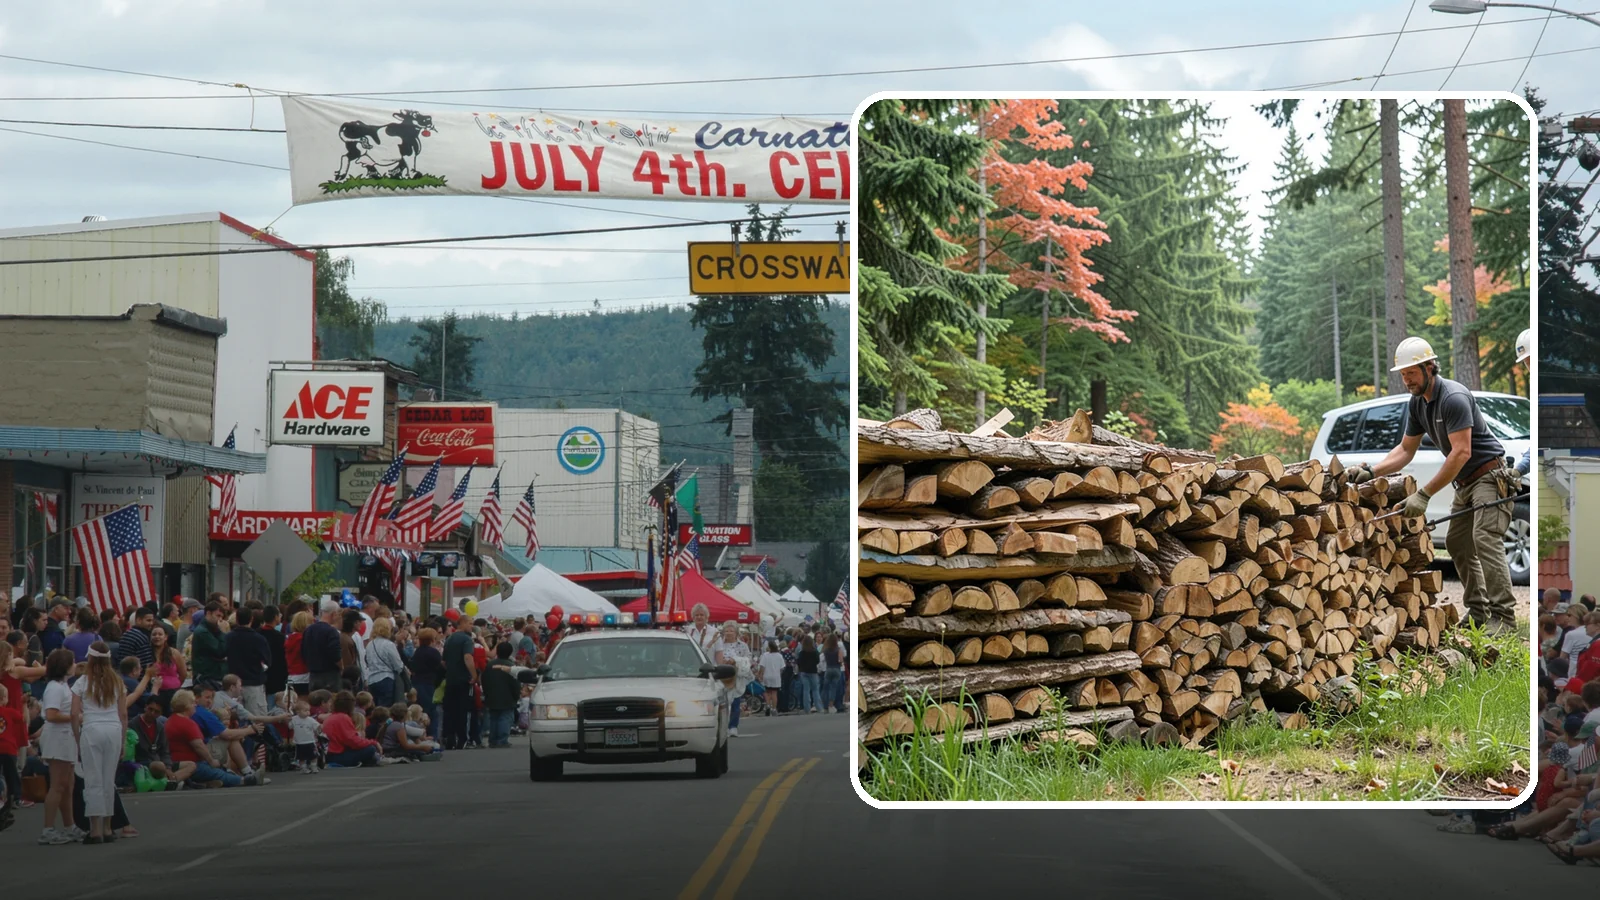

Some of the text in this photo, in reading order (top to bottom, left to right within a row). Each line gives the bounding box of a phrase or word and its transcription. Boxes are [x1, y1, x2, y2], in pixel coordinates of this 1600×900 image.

[694, 121, 850, 150] Carnat
[481, 141, 604, 192] JULY
[632, 149, 746, 197] 4th.
[696, 254, 850, 280] CROSSWA
[282, 380, 373, 420] ACE
[406, 409, 452, 422] CEDAR
[283, 421, 370, 436] Hardware
[416, 428, 476, 447] Coca-Cola
[353, 467, 386, 480] Simpl
[83, 485, 155, 495] St. Vincent de Paul
[80, 503, 154, 522] THRT
[212, 516, 330, 535] HARDARE
[688, 526, 742, 535] CRNATION
[699, 535, 730, 543] GLASS
